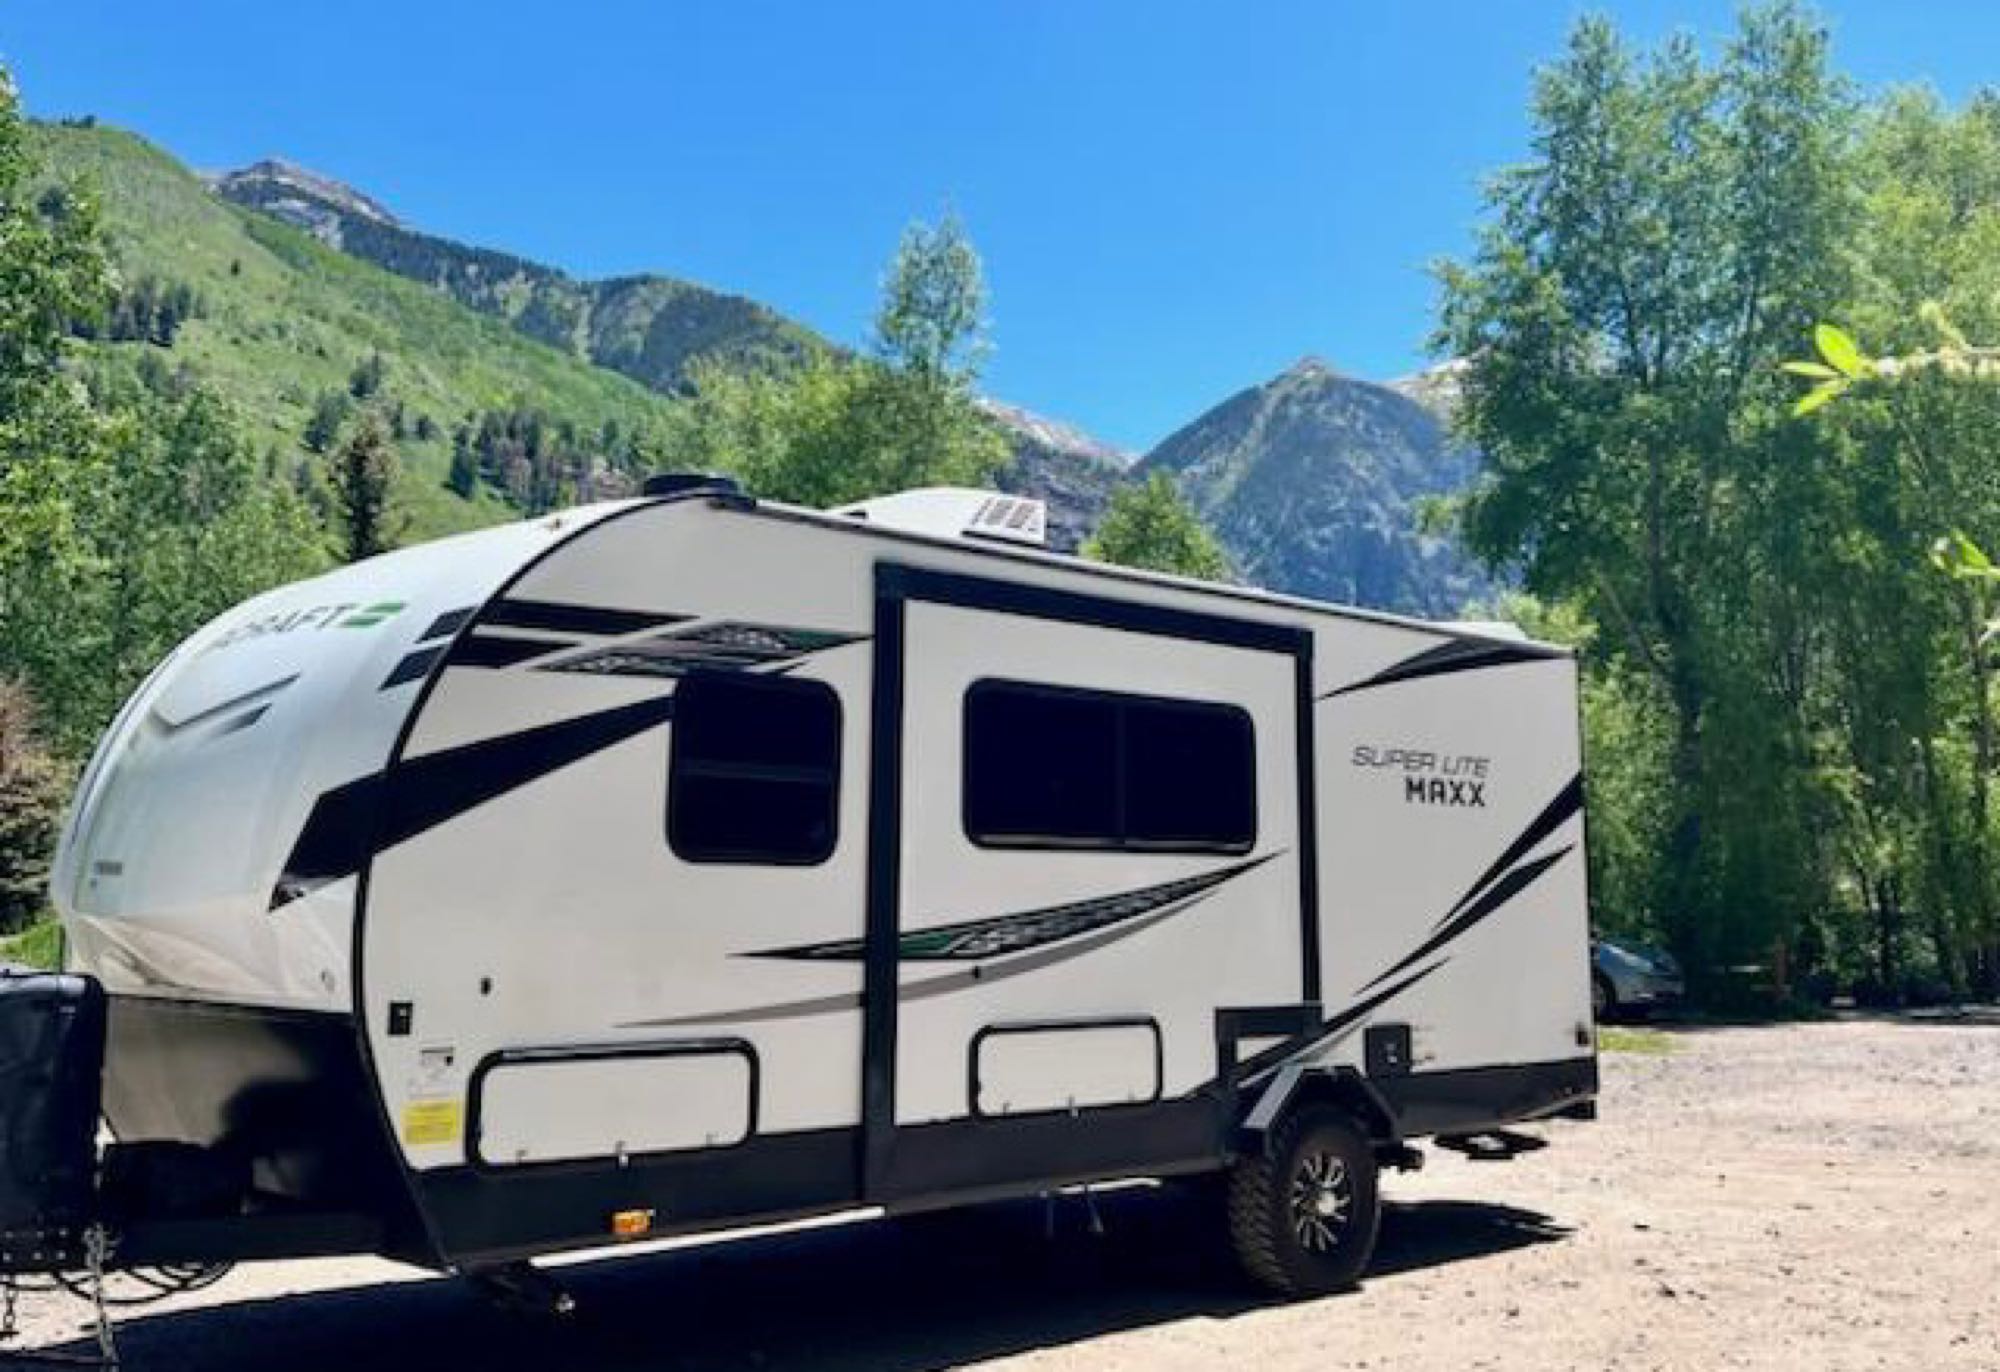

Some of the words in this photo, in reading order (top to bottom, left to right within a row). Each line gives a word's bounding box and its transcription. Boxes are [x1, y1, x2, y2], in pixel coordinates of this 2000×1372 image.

[1352, 746, 1436, 772] SUPER
[1443, 755, 1490, 778] LITE
[1405, 776, 1486, 807] MAXX
